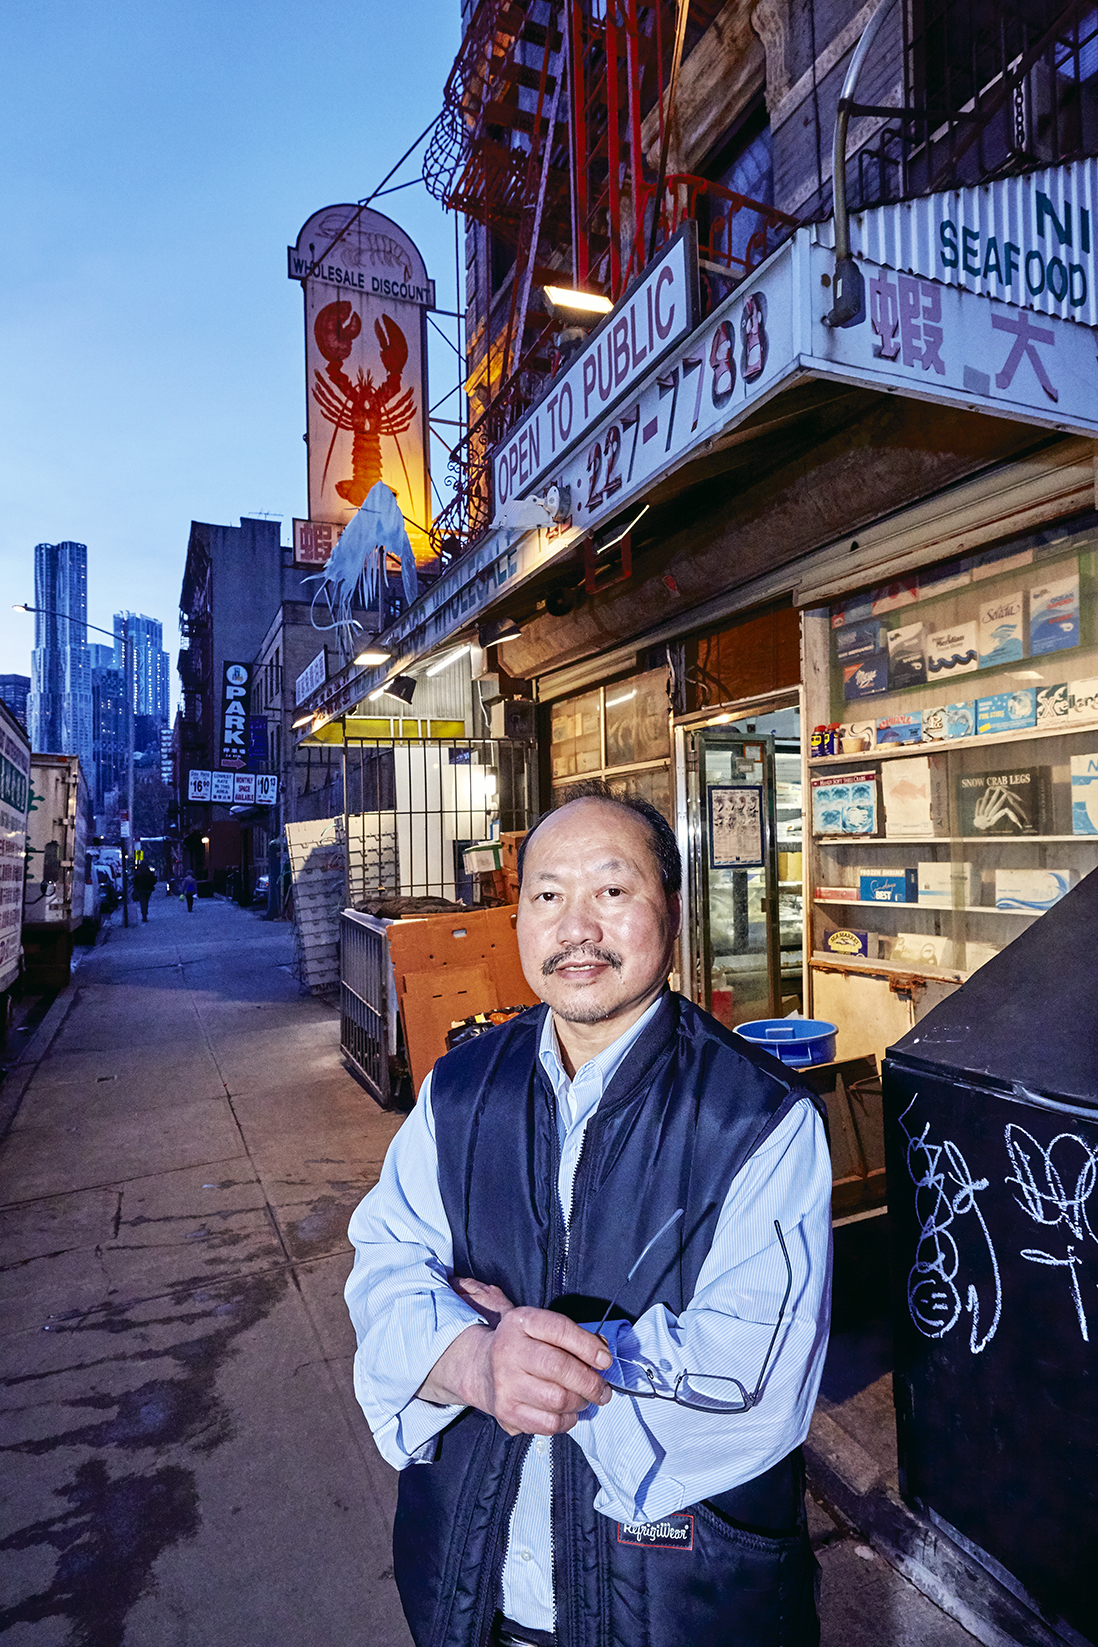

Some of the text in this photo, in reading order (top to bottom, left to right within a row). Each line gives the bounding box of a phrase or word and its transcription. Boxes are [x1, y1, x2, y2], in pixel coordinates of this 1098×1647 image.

[293, 257, 431, 304] WHOLESALE DISCOUNT
[940, 219, 1088, 308] SEAFOOD
[498, 265, 675, 505] OPEN TO PUBLIC
[224, 685, 247, 746] PARK
[961, 773, 1031, 788] SNOW CRAB LEGS
[875, 891, 892, 900] BEST
[882, 869, 905, 877] SHRIMP
